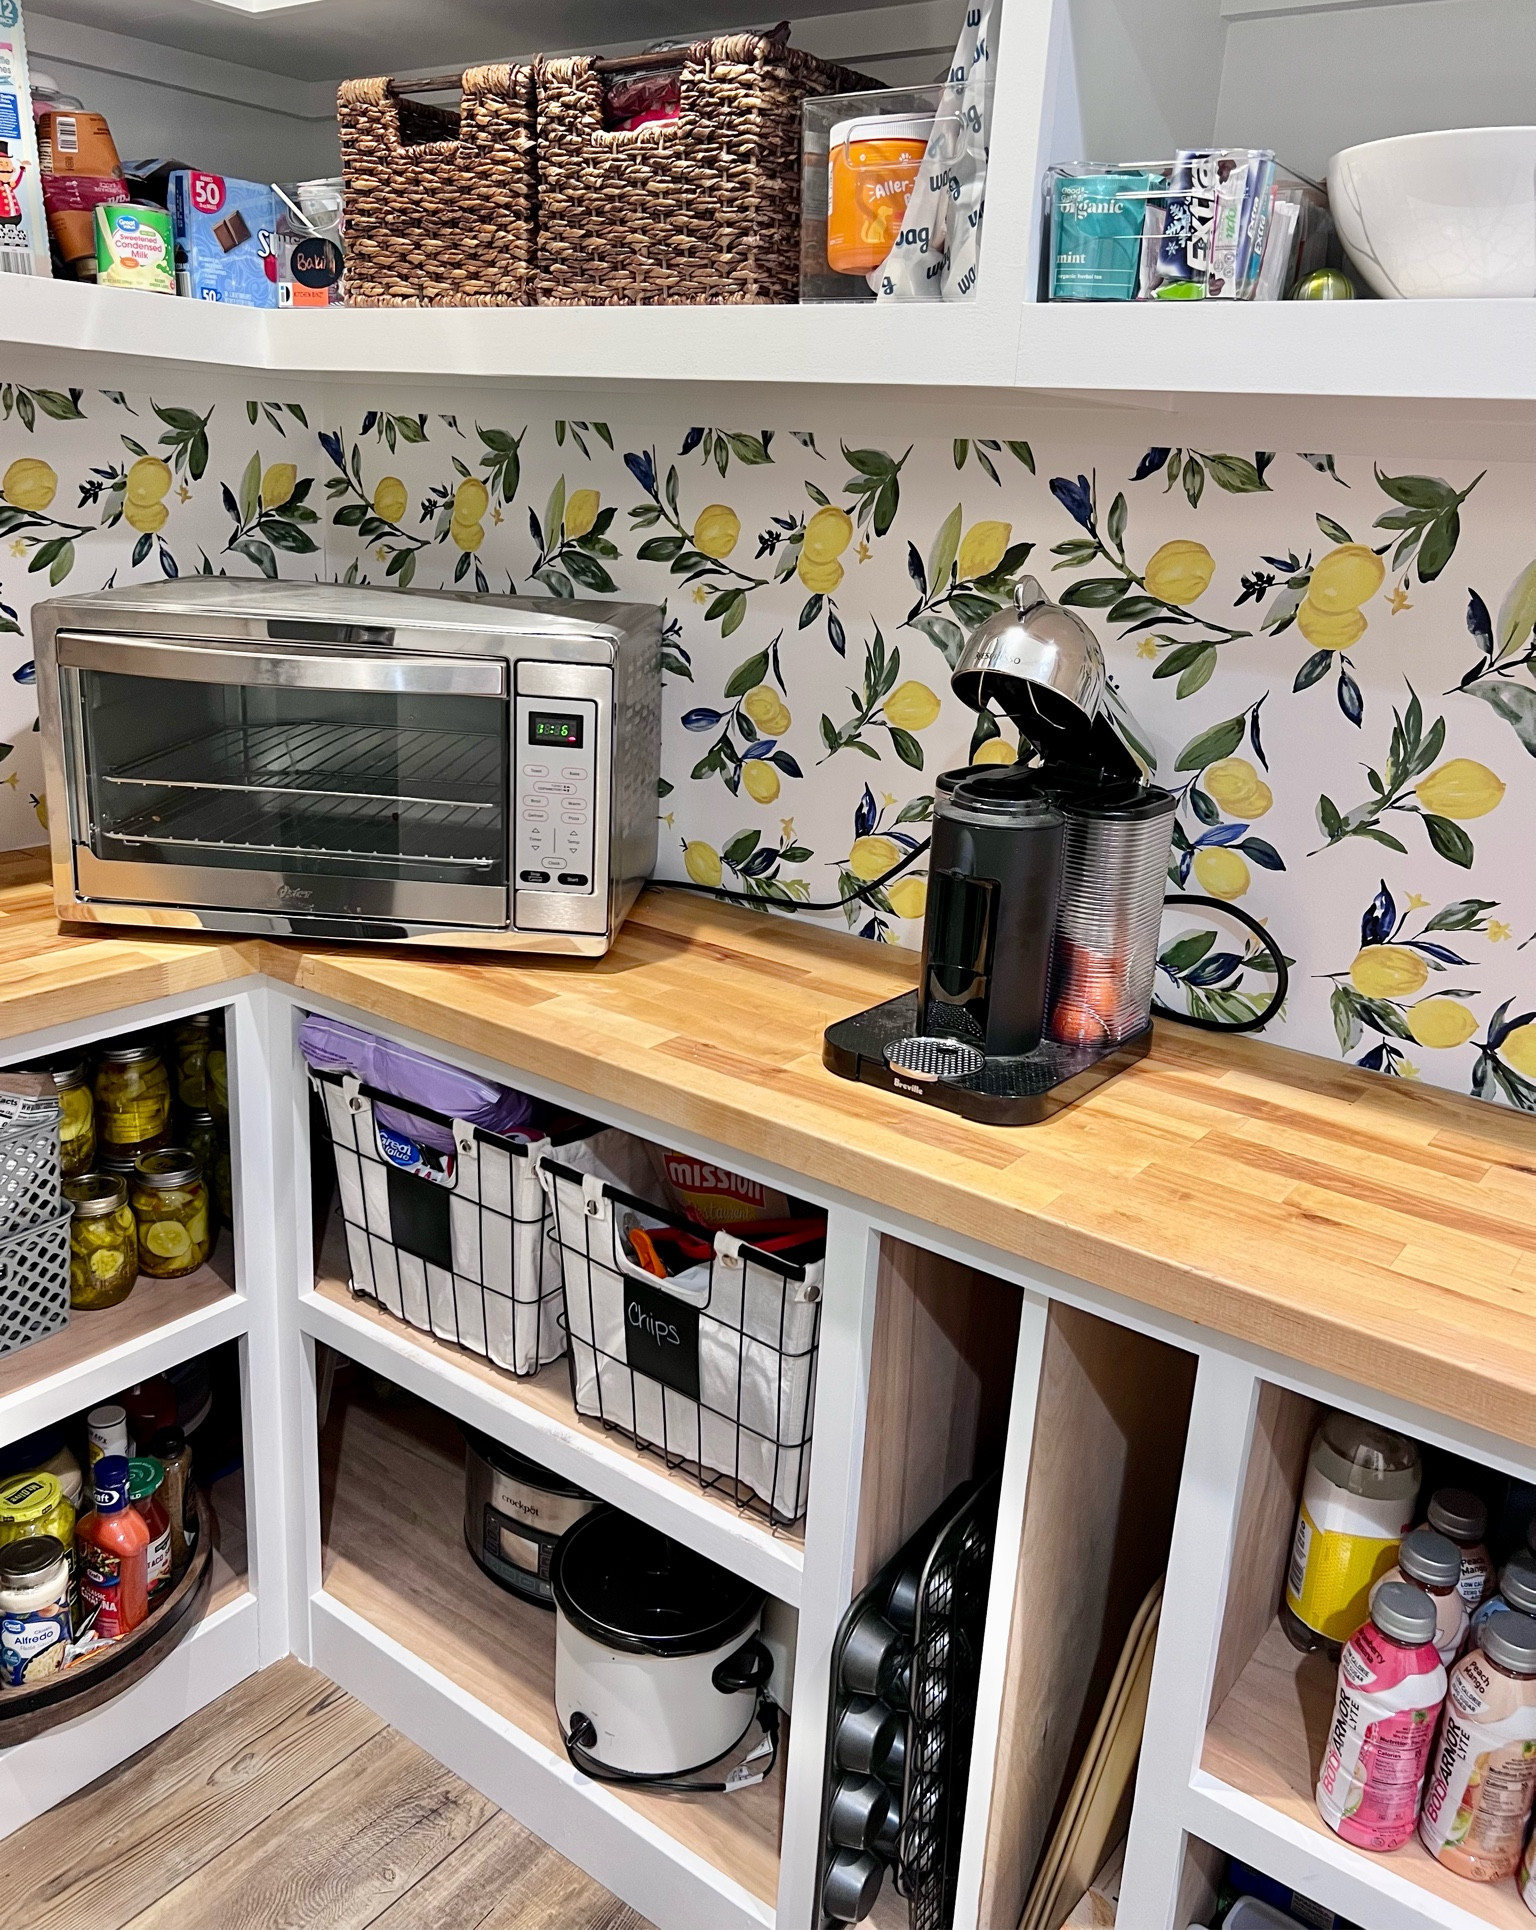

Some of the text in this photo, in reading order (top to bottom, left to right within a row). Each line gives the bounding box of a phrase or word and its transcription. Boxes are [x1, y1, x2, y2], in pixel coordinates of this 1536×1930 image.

[195, 181, 220, 205] 50
[1060, 199, 1124, 220] organic
[118, 218, 136, 227] Great
[120, 233, 158, 244] Sweetened
[1254, 214, 1266, 255] Extra
[115, 239, 163, 253] Condensed
[131, 250, 149, 259] Milk
[1057, 251, 1087, 264] mint
[893, 1077, 924, 1096] Breville
[380, 1131, 412, 1156] Great
[628, 1301, 681, 1346] Chips
[93, 1492, 110, 1503] raft
[14, 1630, 54, 1645] Alfredo
[1463, 1666, 1486, 1694] Mango
[1469, 1660, 1490, 1687] Peach
[1461, 1685, 1482, 1708] CALORIE
[1348, 1698, 1360, 1731] LYTE
[1377, 1748, 1402, 1759] Calories
[1456, 1728, 1471, 1761] LYTE
[1426, 1716, 1461, 1824] BODYARMOR
